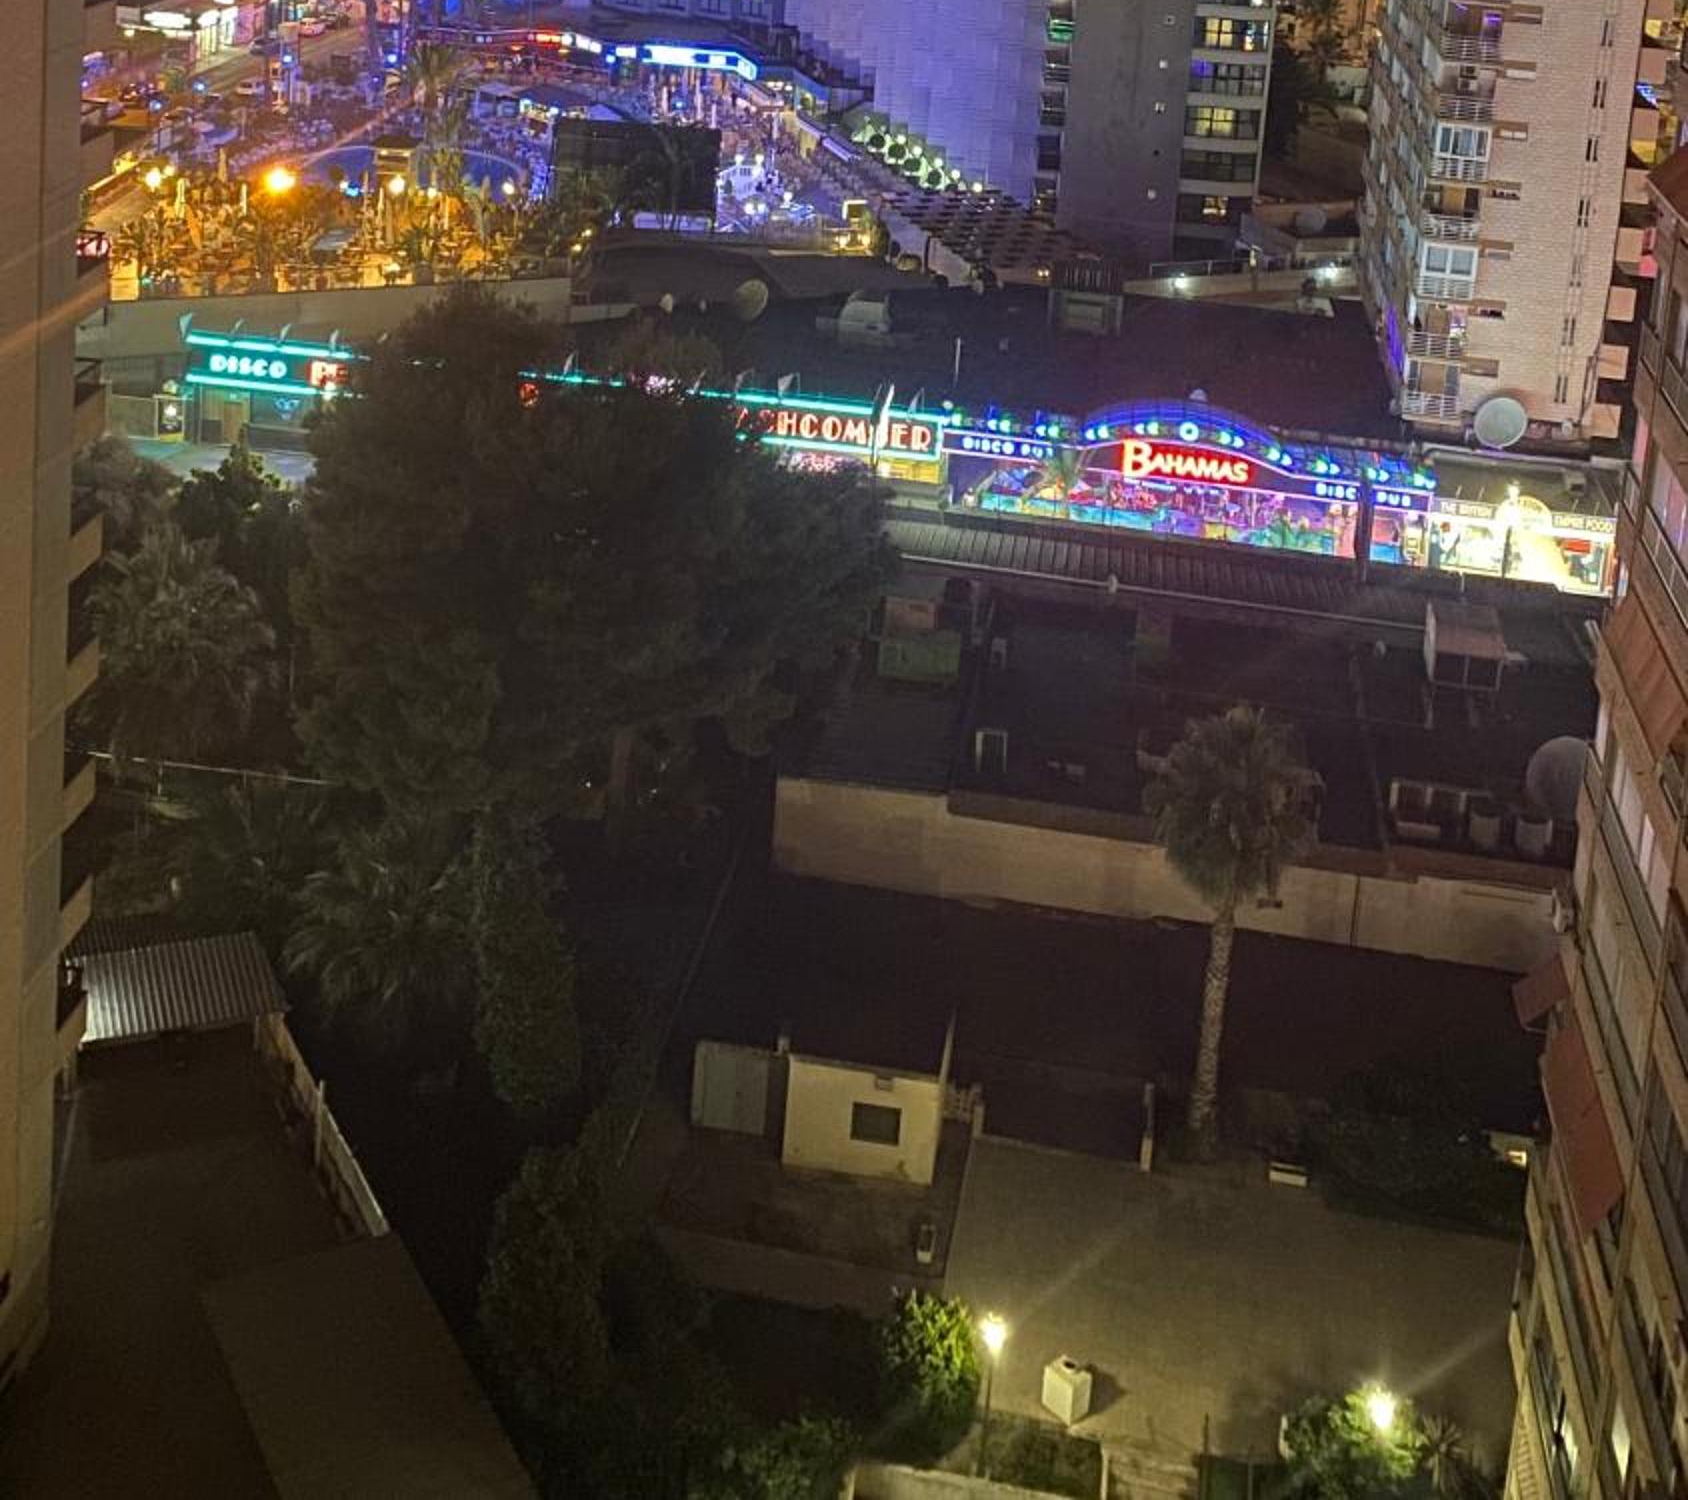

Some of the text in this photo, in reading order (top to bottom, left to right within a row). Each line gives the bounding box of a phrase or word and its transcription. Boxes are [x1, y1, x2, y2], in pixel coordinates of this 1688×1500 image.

[209, 353, 288, 379] DISCO
[962, 436, 1015, 455] DISCO
[1122, 440, 1250, 483] BAHAMAS
[1315, 482, 1412, 508] DISC PUB
